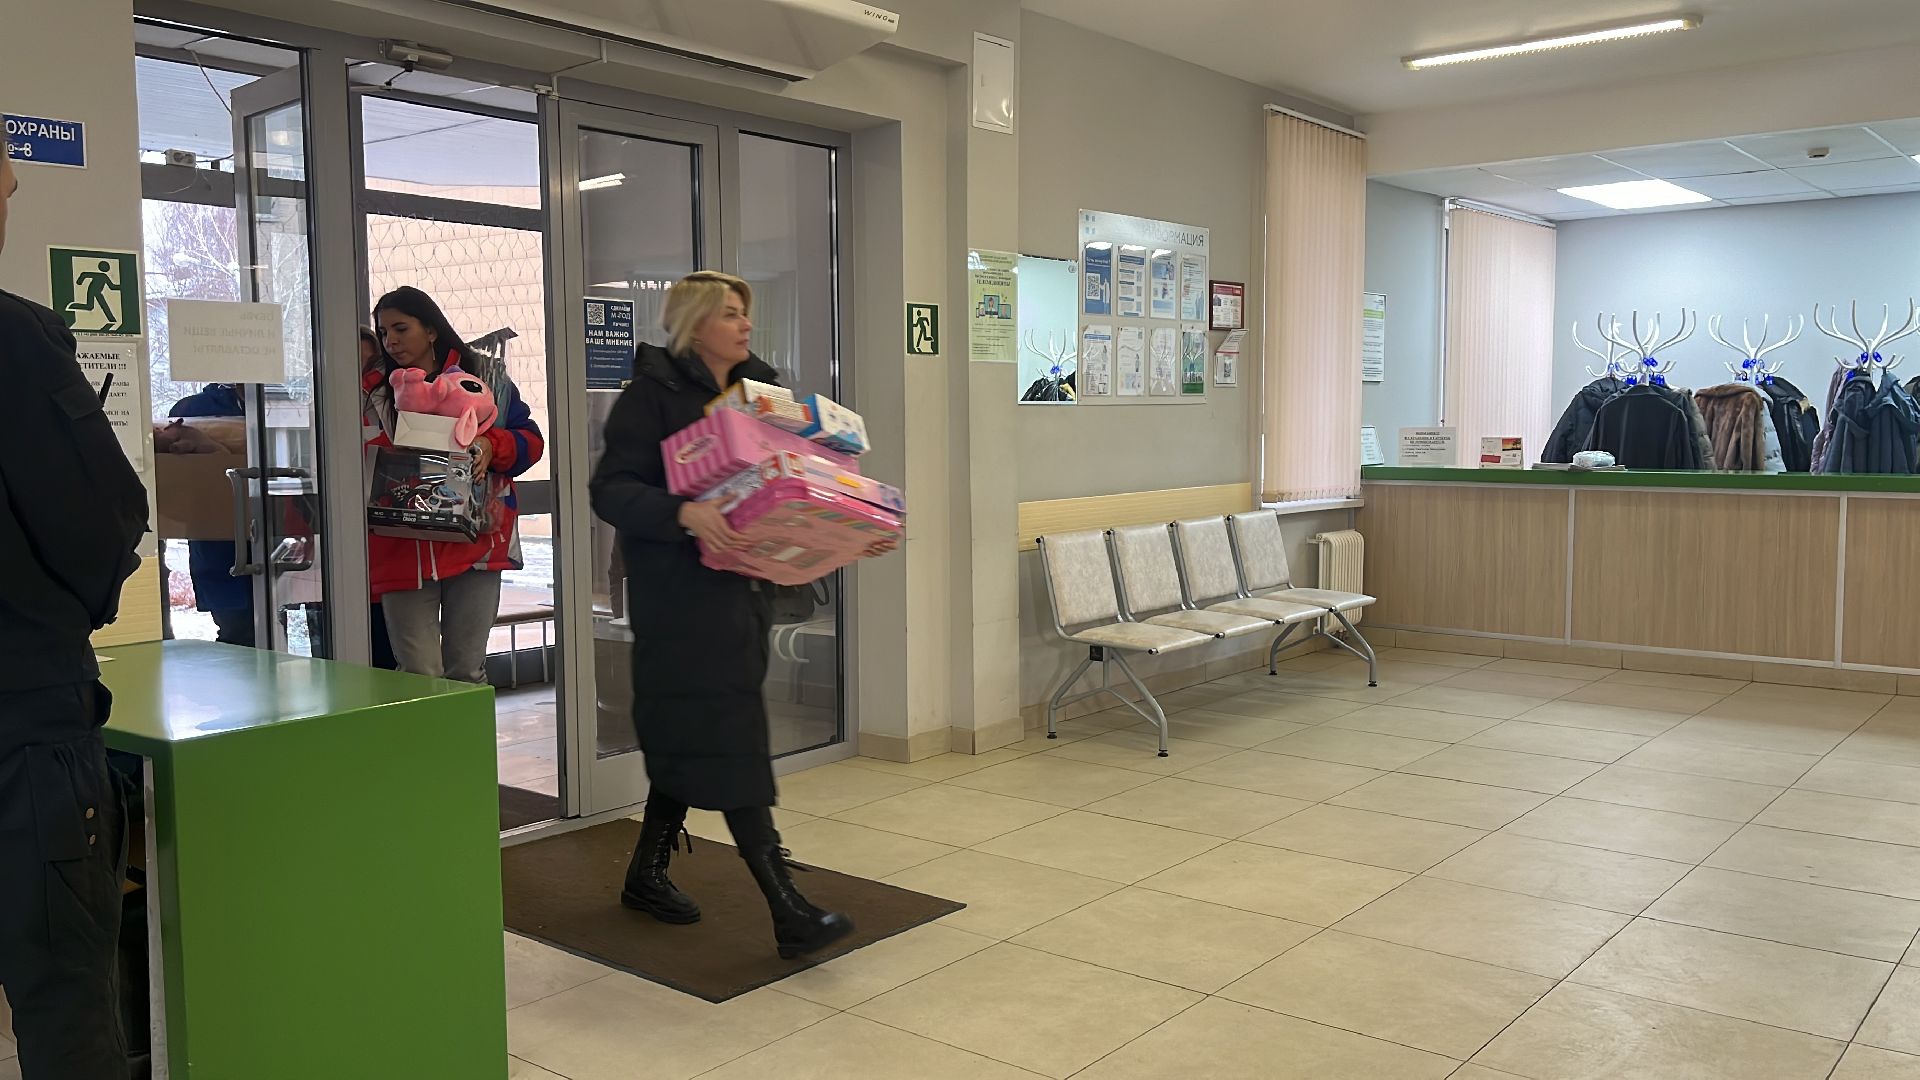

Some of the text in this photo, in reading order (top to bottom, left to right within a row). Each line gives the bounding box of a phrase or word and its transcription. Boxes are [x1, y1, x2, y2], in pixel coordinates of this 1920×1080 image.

[864, 9, 888, 21] WING
[5, 120, 75, 141] ОХРАНЫ
[588, 329, 630, 338] НАМ ВАЖНО
[606, 338, 633, 347] МНЕНИЕ
[76, 352, 120, 360] АЖАЕМЫЕ
[80, 362, 117, 370] ТИТЕЛИ
